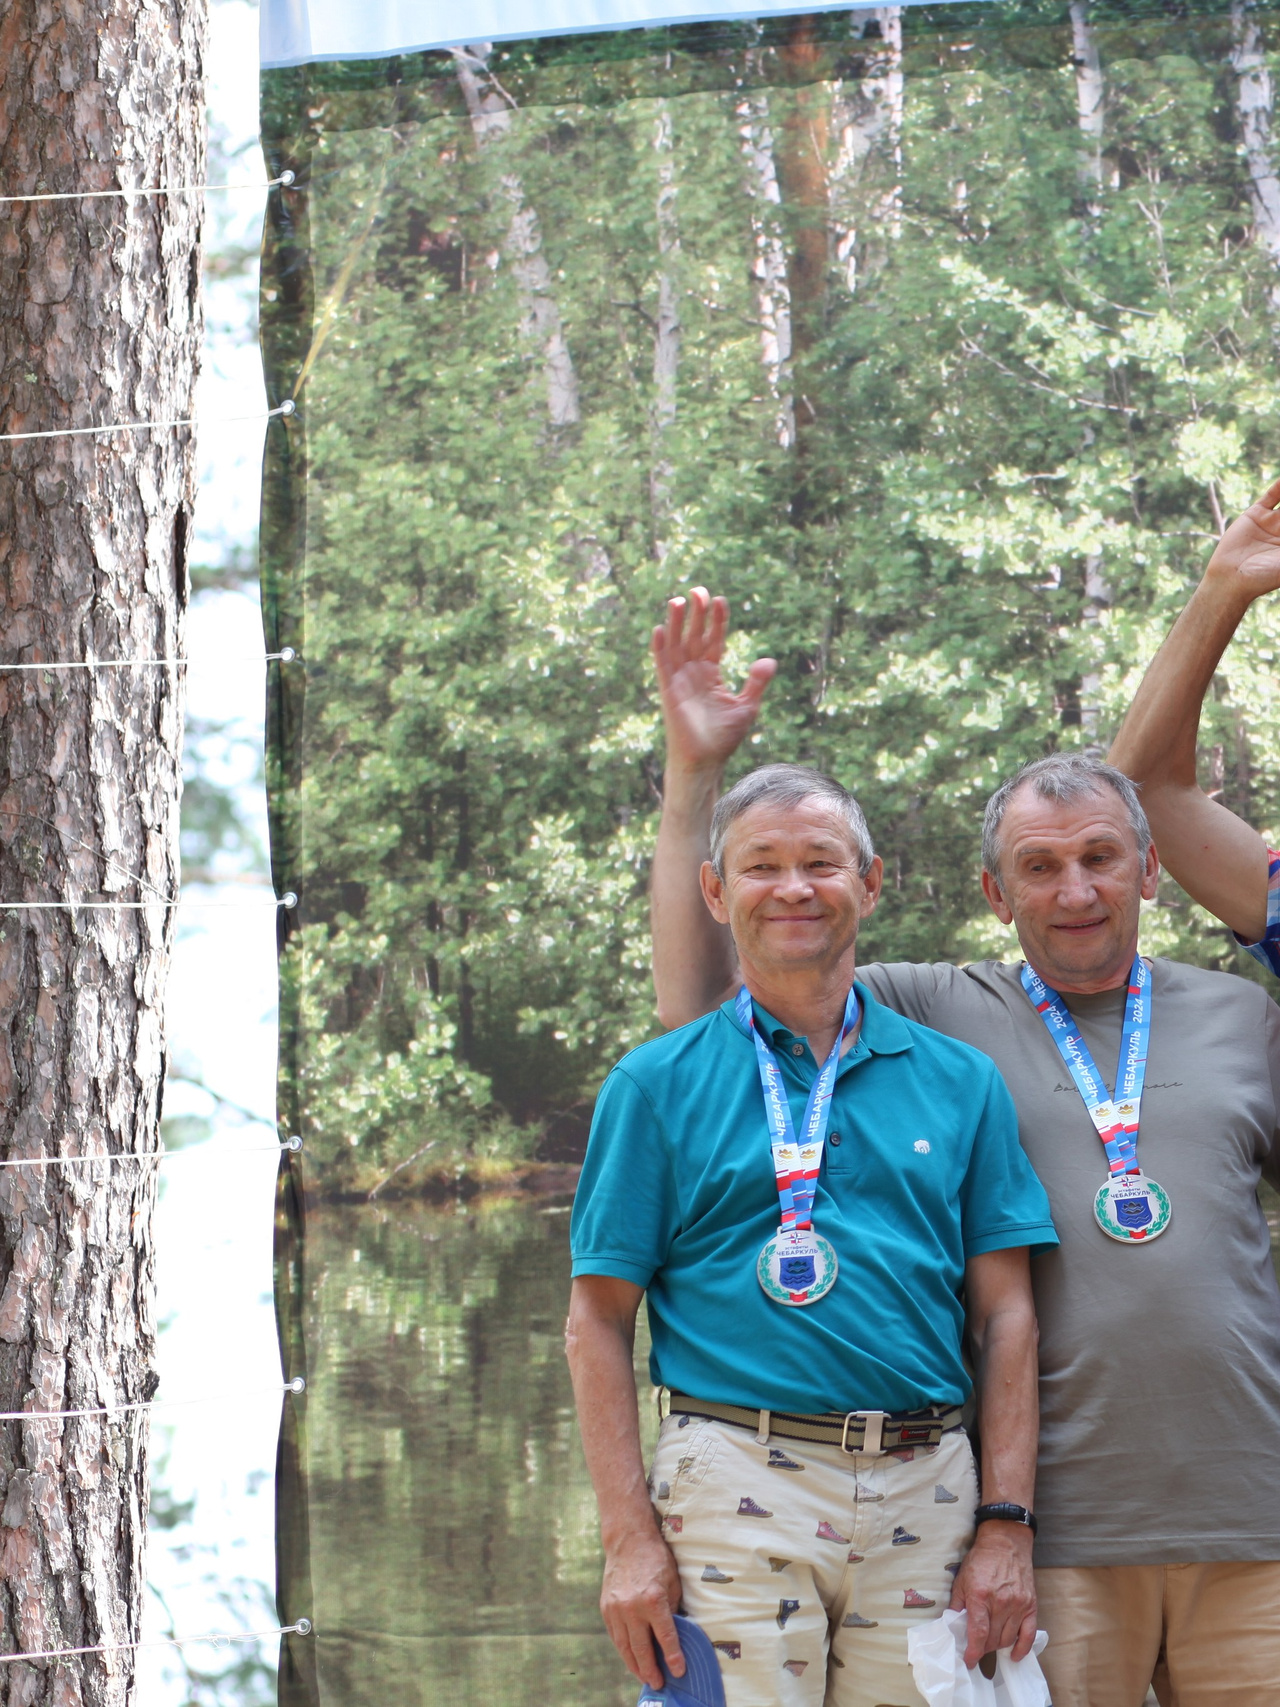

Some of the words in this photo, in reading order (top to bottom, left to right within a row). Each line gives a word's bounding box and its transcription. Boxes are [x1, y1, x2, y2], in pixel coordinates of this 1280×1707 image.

[1046, 1005, 1067, 1029] 2024
[1123, 1030, 1140, 1094] ЧЕБАРКУЛЬ
[1133, 998, 1144, 1024] 2024
[765, 1062, 786, 1136] ЧЕБАРКУЛЬ
[1064, 1035, 1098, 1098] ЧЕБАРКУЛЬ
[807, 1065, 832, 1137] ЧЕБАРКУЛЬ
[1111, 1190, 1150, 1198] ЧЕБАРКУЛЬ
